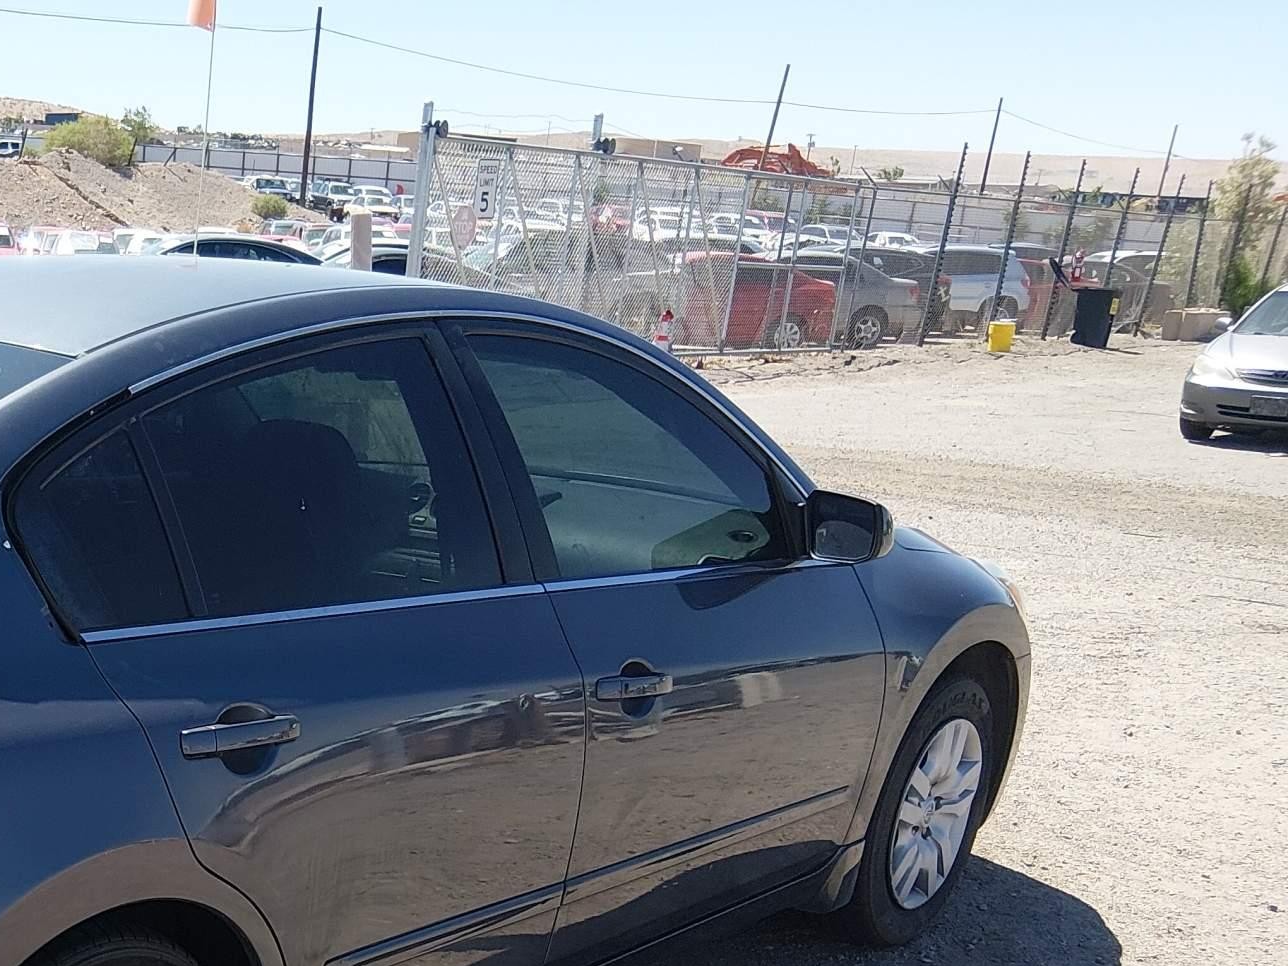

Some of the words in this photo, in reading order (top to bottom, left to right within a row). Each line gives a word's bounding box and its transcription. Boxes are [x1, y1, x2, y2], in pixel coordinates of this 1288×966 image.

[480, 165, 497, 174] SPEED
[480, 178, 494, 187] LIMIT
[479, 191, 489, 212] 5
